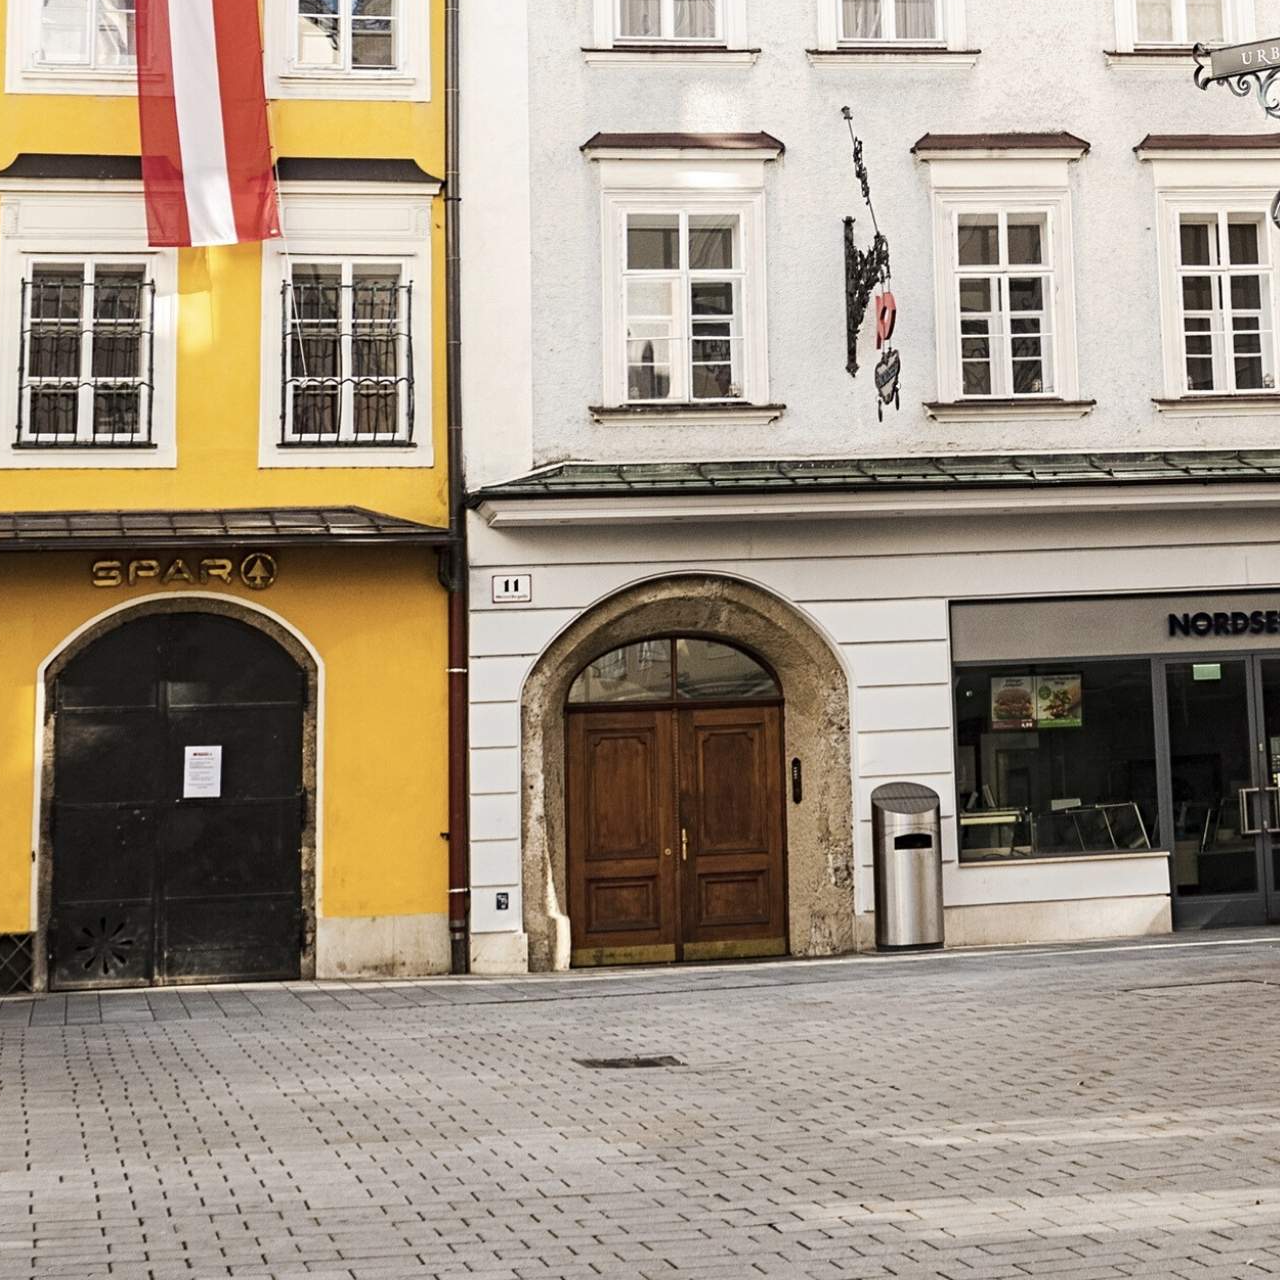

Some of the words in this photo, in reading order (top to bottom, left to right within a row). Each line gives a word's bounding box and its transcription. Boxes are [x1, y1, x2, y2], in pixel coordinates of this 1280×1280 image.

[1241, 47, 1280, 65] URB
[93, 559, 232, 587] SPAR
[504, 579, 519, 592] 11
